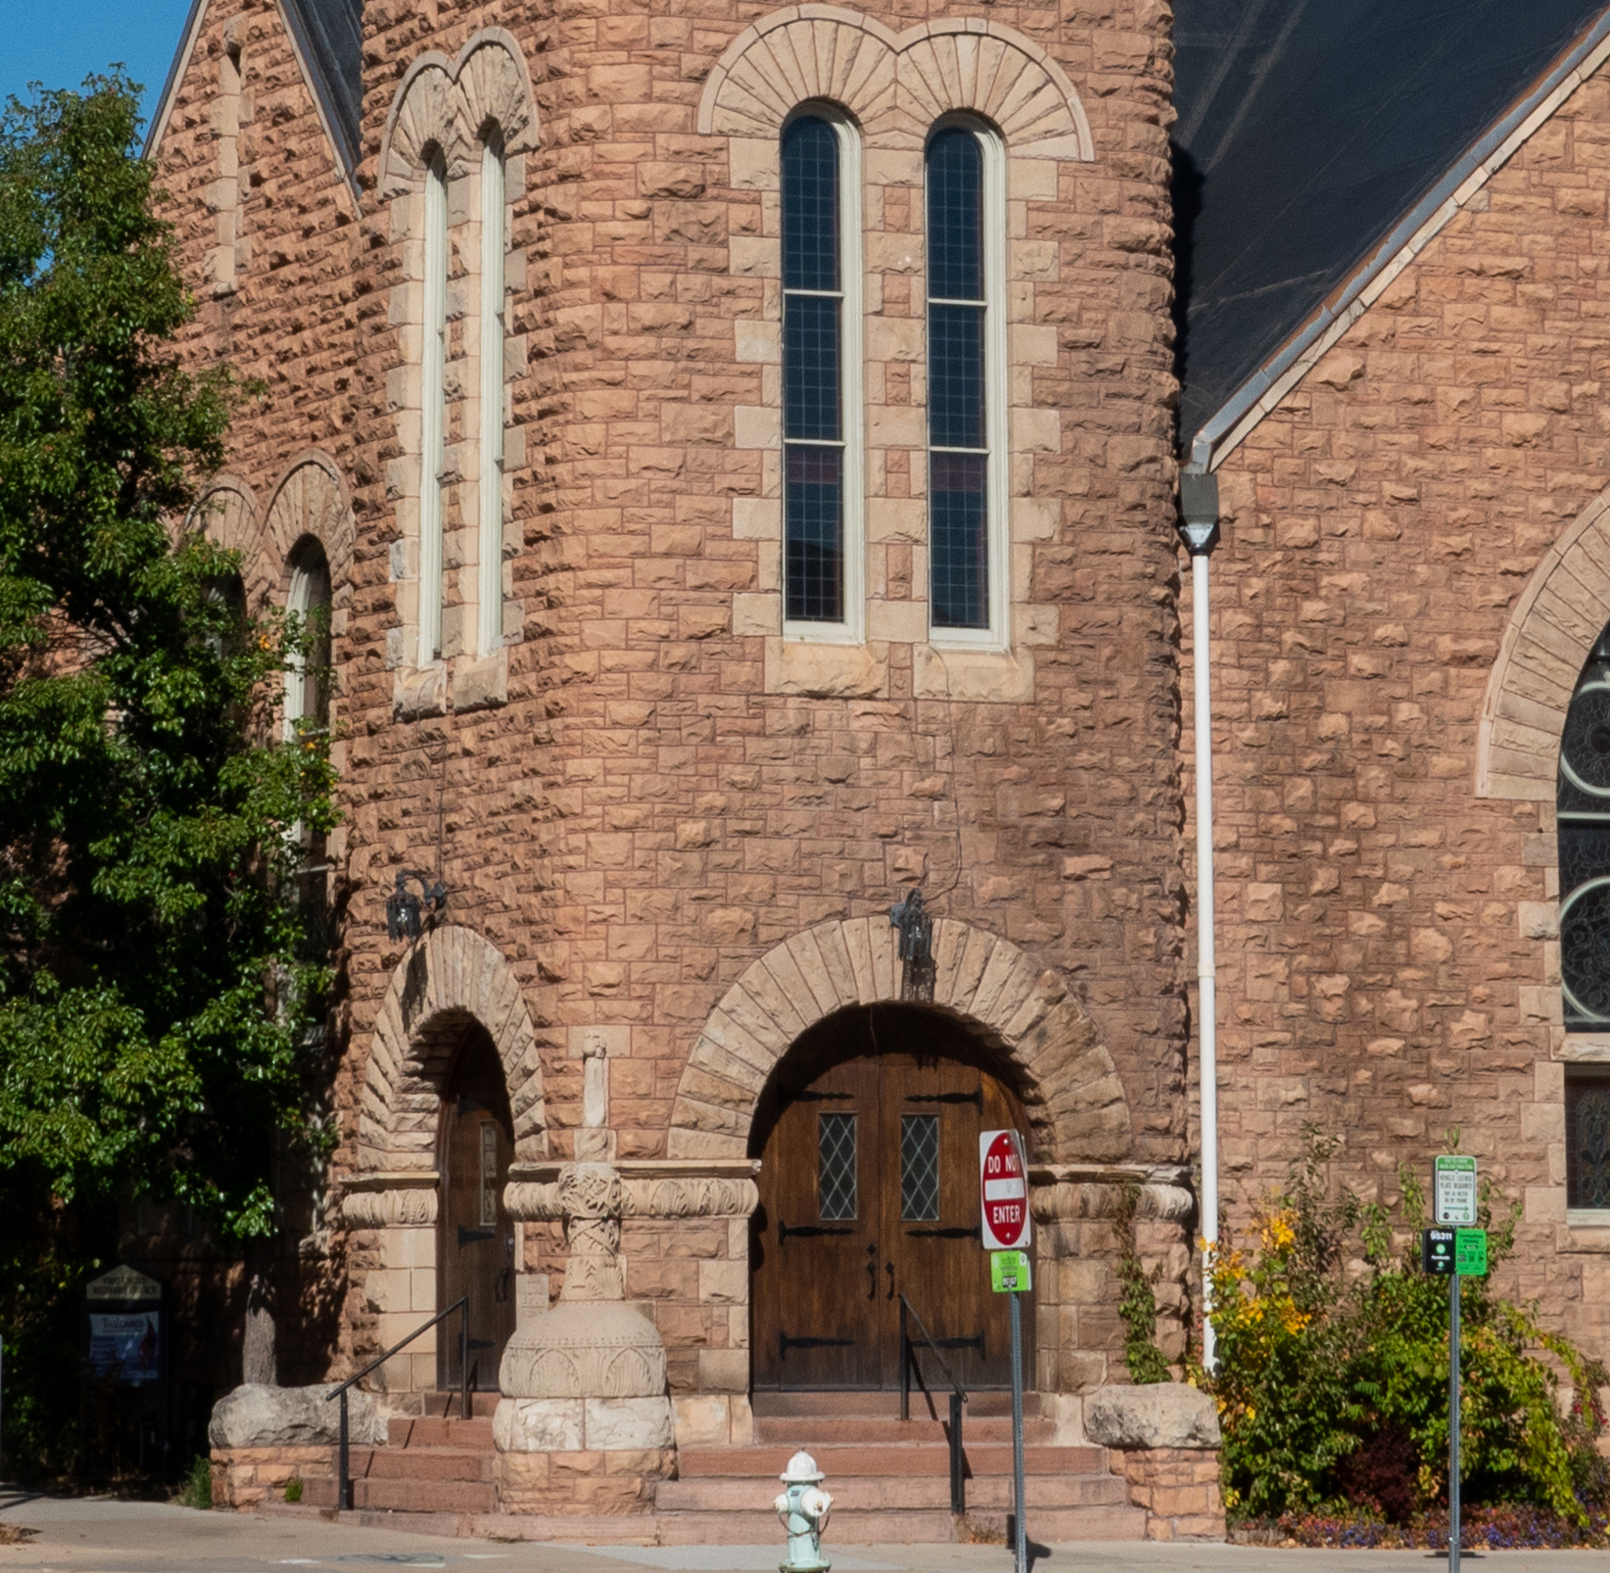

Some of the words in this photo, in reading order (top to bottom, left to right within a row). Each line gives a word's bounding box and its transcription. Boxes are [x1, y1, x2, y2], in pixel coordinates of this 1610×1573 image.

[987, 1155, 1001, 1174] DO
[1005, 1154, 1020, 1173] NOT
[993, 1205, 1021, 1224] ENTER
